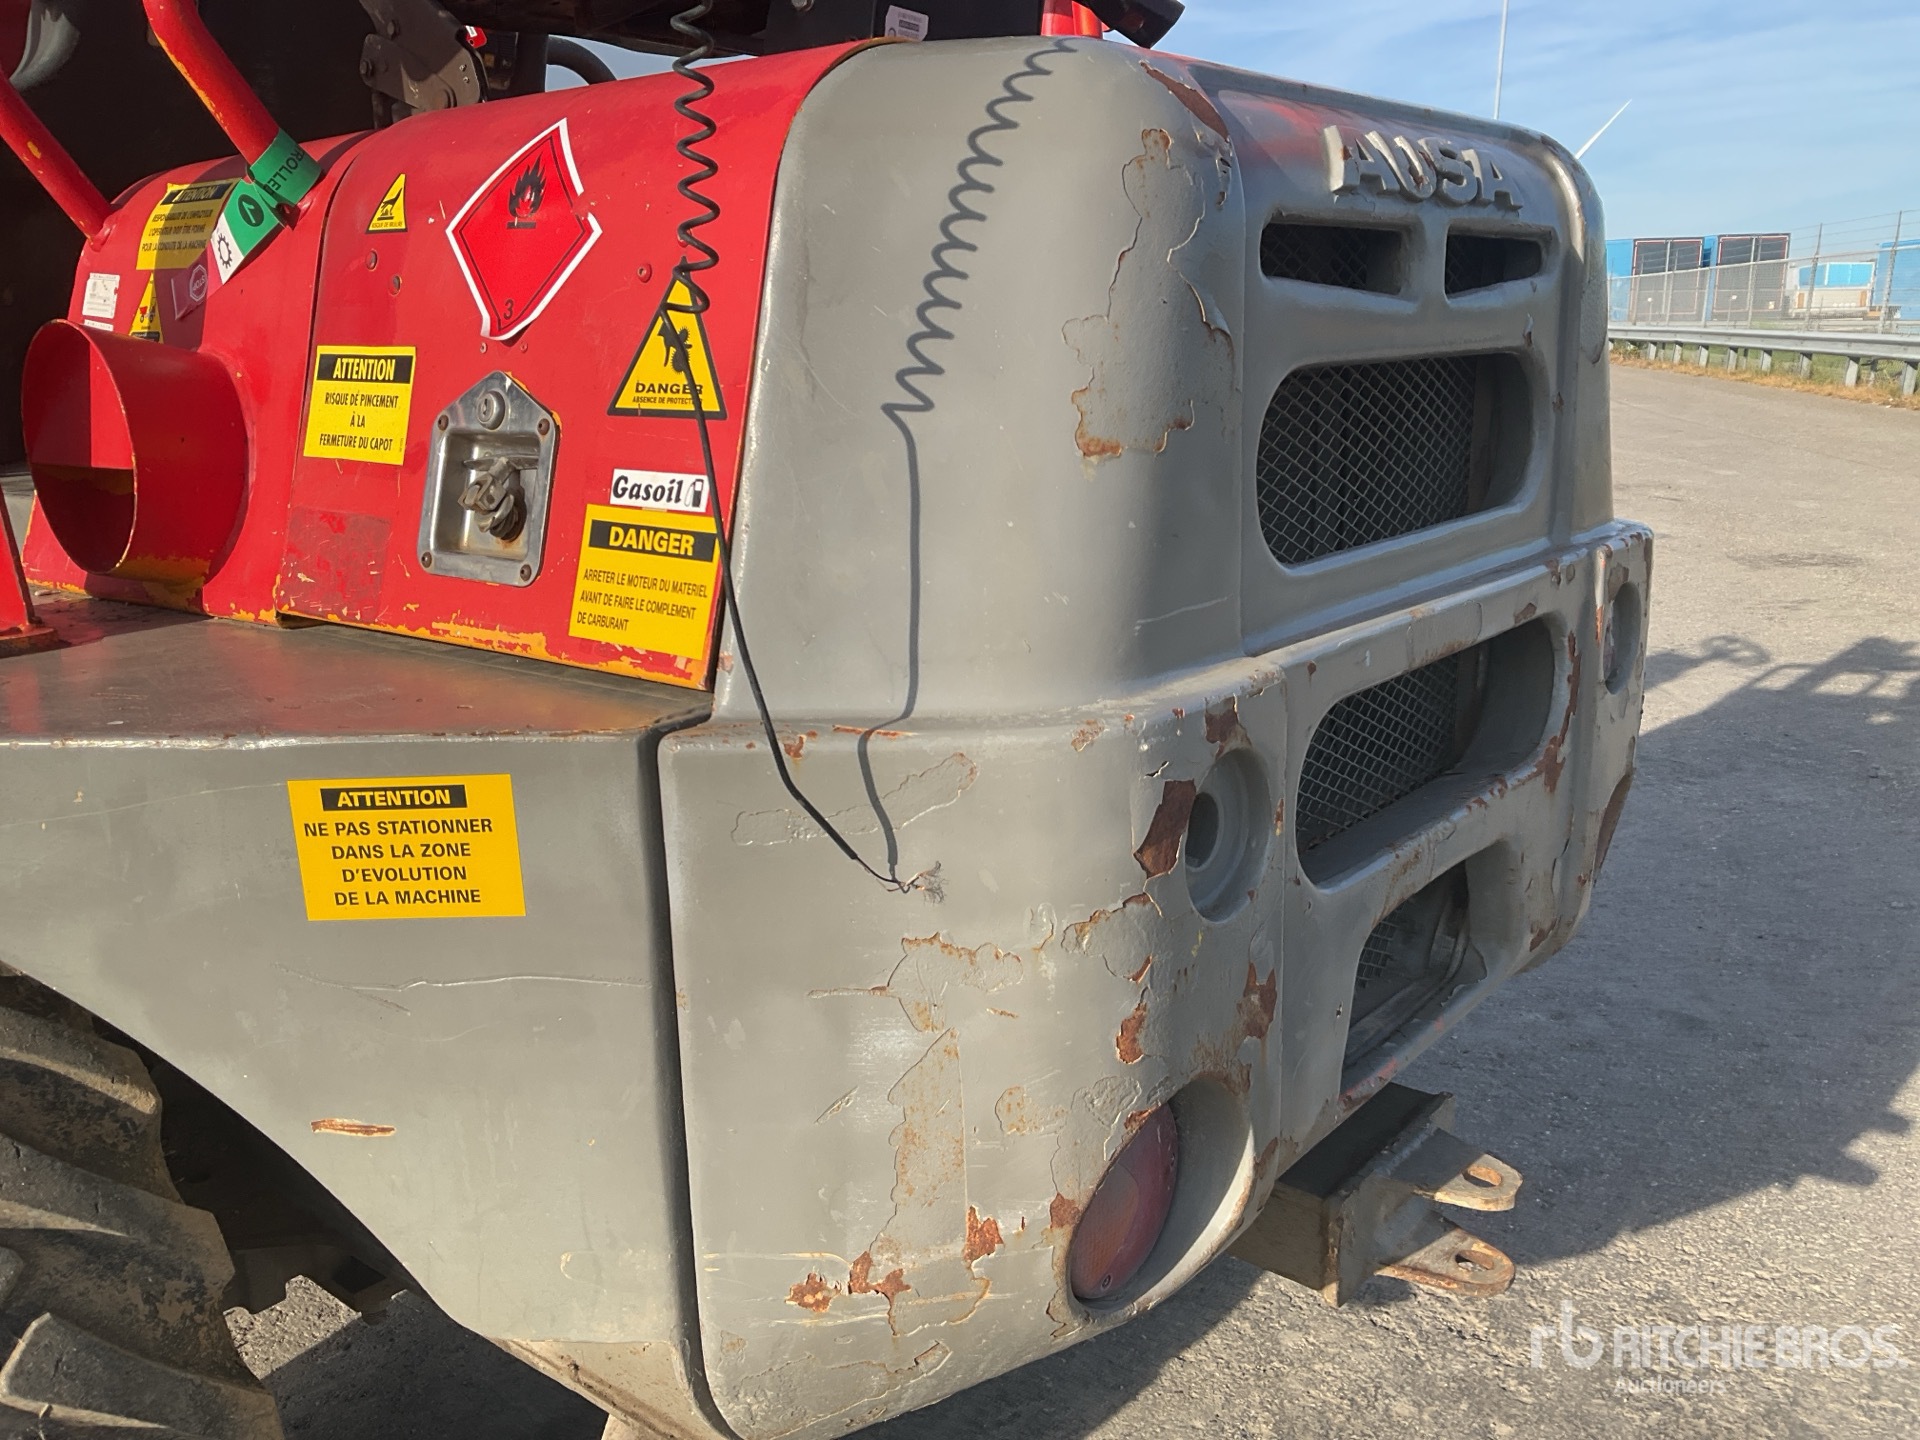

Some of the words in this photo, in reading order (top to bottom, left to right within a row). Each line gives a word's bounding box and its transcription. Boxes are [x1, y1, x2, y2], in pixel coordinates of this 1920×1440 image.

[1324, 124, 1523, 211] AUSA
[142, 242, 152, 251] POUR
[503, 298, 514, 320] 3
[333, 357, 396, 381] ATTENTION
[325, 392, 348, 406] RISQUE
[349, 393, 358, 406] DE
[360, 394, 399, 408] PINCEMENT
[632, 396, 657, 404] ABSENCE
[659, 396, 666, 404] DE
[357, 415, 365, 428] LA
[319, 433, 357, 448] FERMETURE
[358, 436, 368, 449] DU
[370, 437, 393, 451] CAPOT
[612, 475, 684, 504] Gasoil
[609, 525, 695, 556] DANGER
[583, 568, 616, 583] ARRETER
[616, 572, 626, 586] LE
[627, 574, 657, 591] MOTEUR
[659, 579, 670, 591] DU
[671, 580, 708, 598] MATERIEL
[580, 589, 602, 606] AVANT
[603, 593, 613, 607] DE
[613, 595, 635, 610] FAIRE
[635, 598, 645, 611] LE
[646, 599, 697, 620] COMPLEMENT
[577, 611, 587, 625] DE
[587, 613, 629, 631] CARBURANT
[337, 789, 450, 808] ATTENTION
[304, 822, 329, 837] NE
[335, 821, 371, 836] PAS
[377, 818, 493, 835] STATIONNER
[331, 844, 384, 859] DANS
[390, 843, 415, 858] LA
[420, 842, 471, 857] ZONE
[342, 866, 467, 883] D'EVOLUTION
[334, 891, 359, 906] DE
[365, 890, 389, 905] LA
[395, 889, 481, 904] MACHINE
